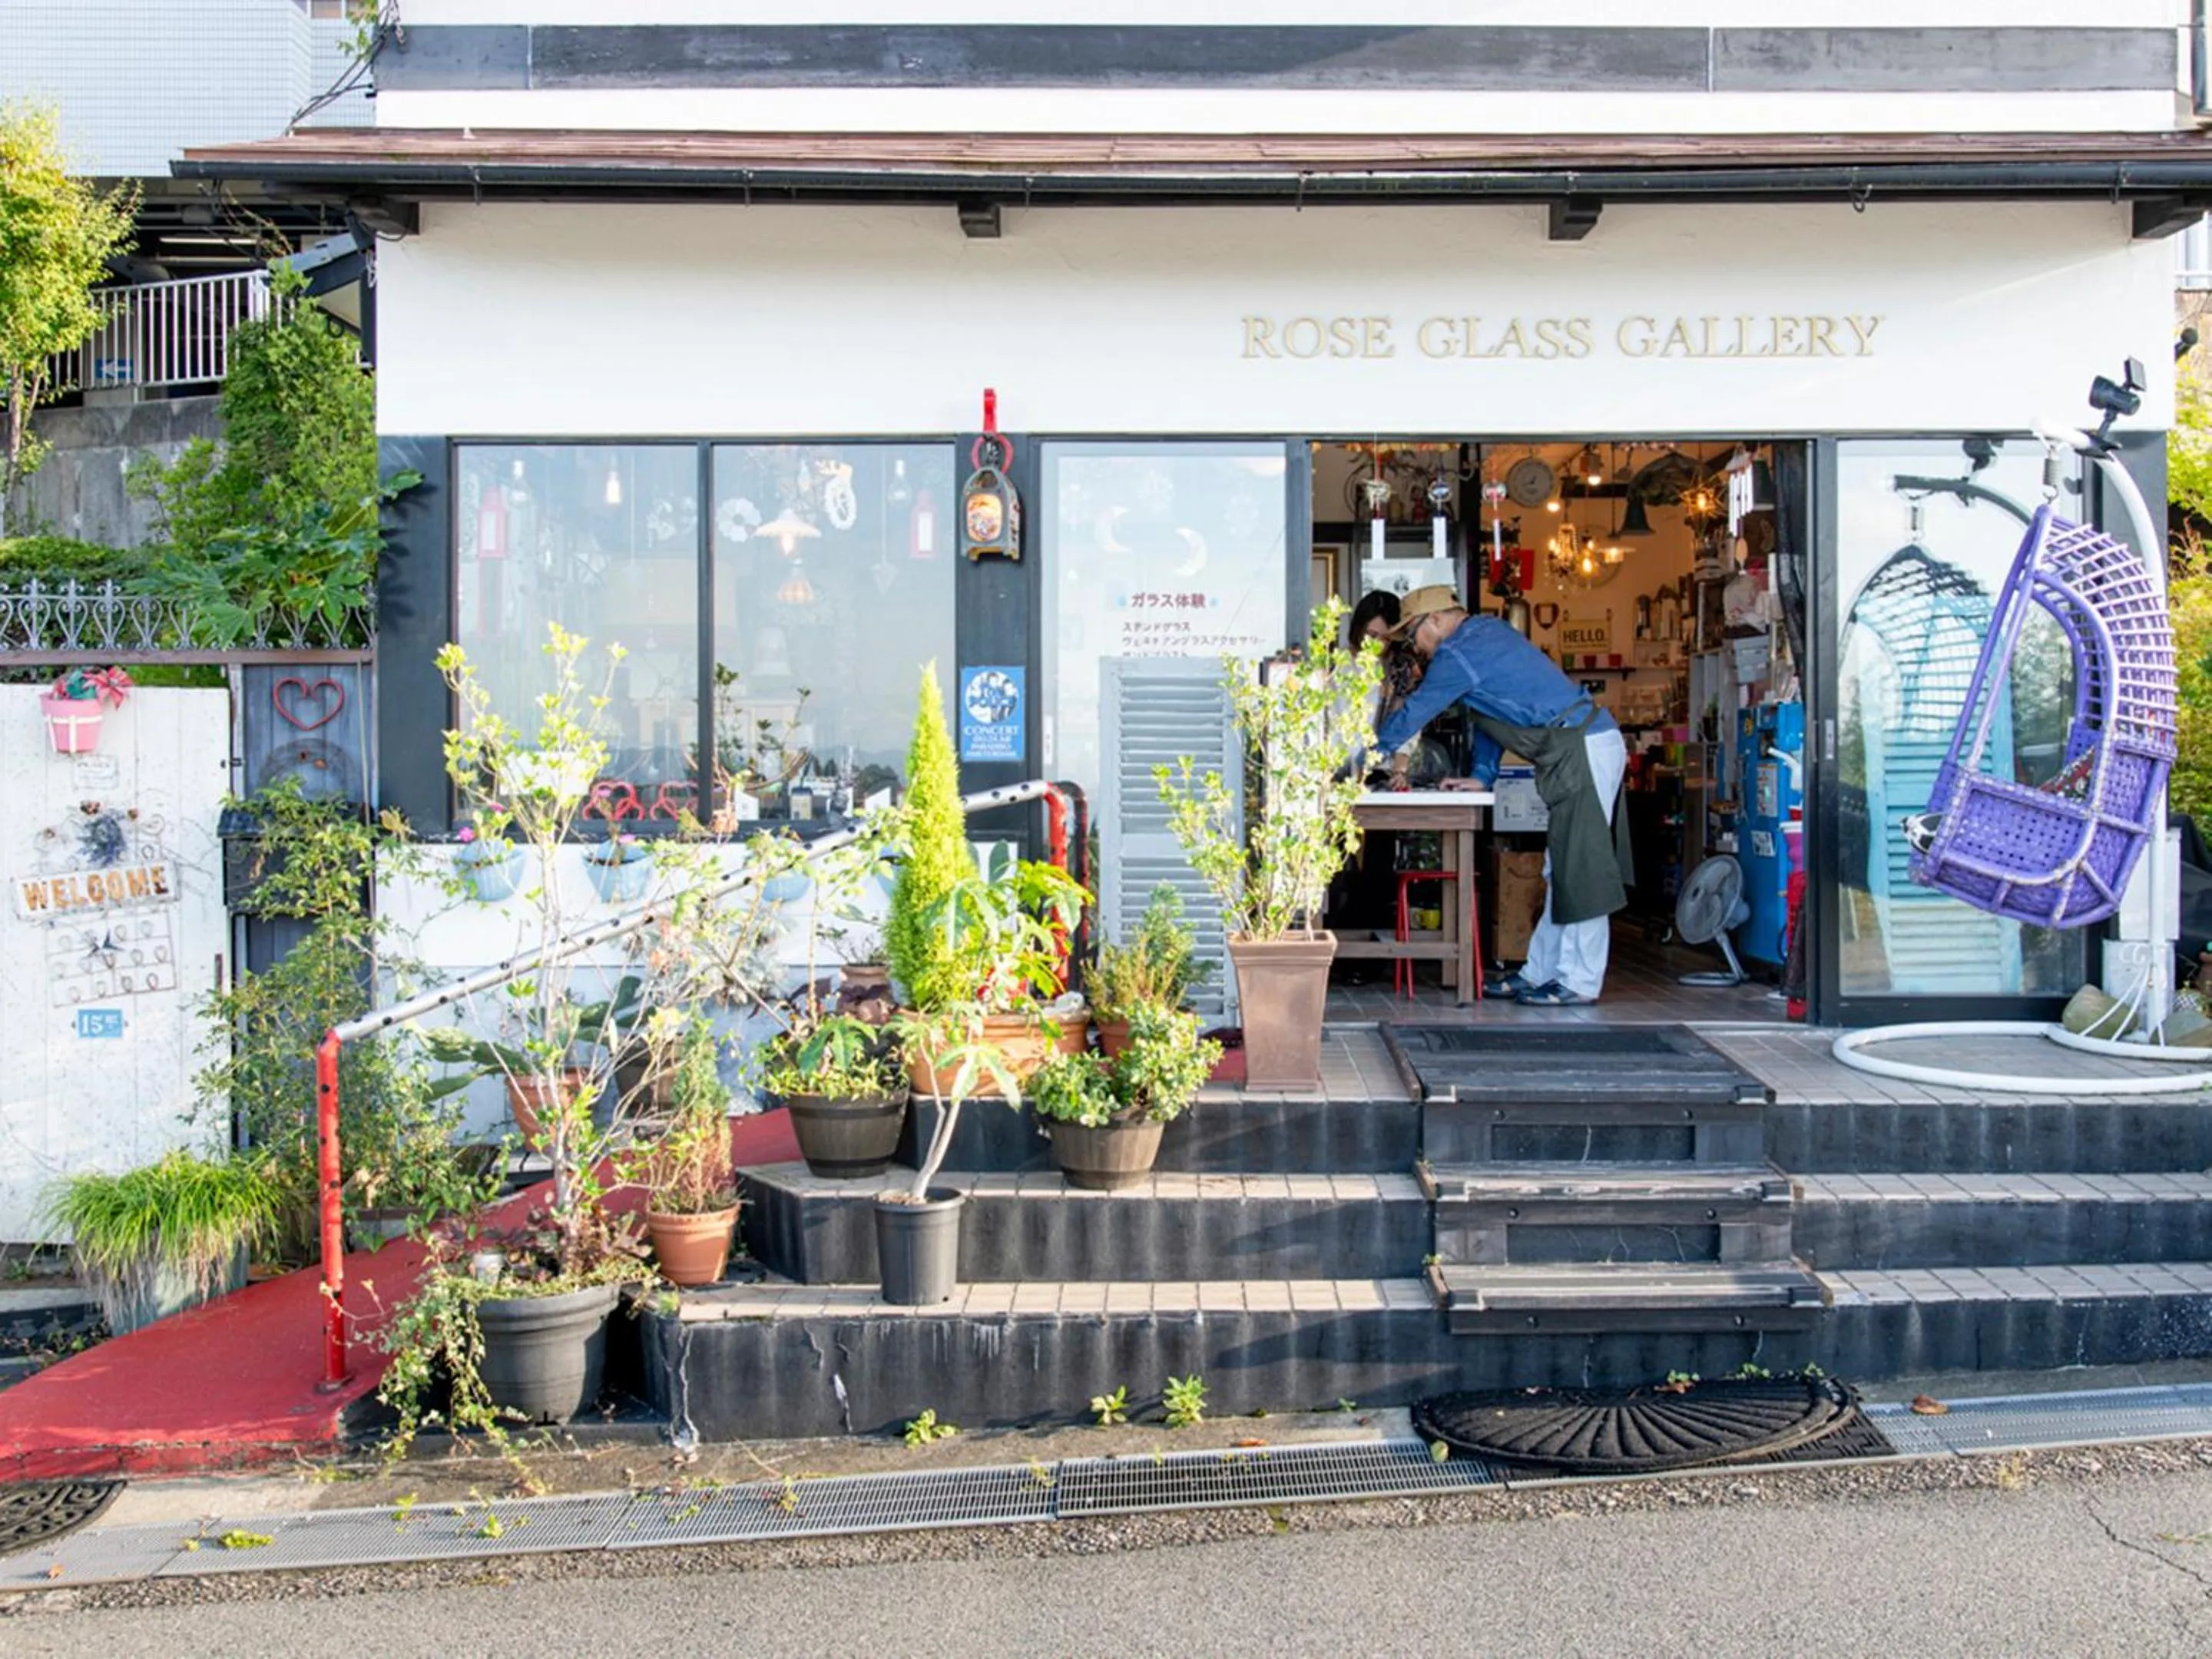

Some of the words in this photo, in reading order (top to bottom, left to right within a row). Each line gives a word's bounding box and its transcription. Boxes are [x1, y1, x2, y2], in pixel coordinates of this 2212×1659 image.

[1240, 316, 1394, 359] ROSE
[1417, 316, 1595, 359] GLASS
[1617, 316, 1887, 357] GALLERY
[1131, 591, 1206, 609] ガラス体験
[1122, 621, 1191, 632] ステンドグラス
[1563, 628, 1604, 642] HELLO
[22, 865, 169, 911] WELCOME
[81, 1014, 104, 1035] 15
